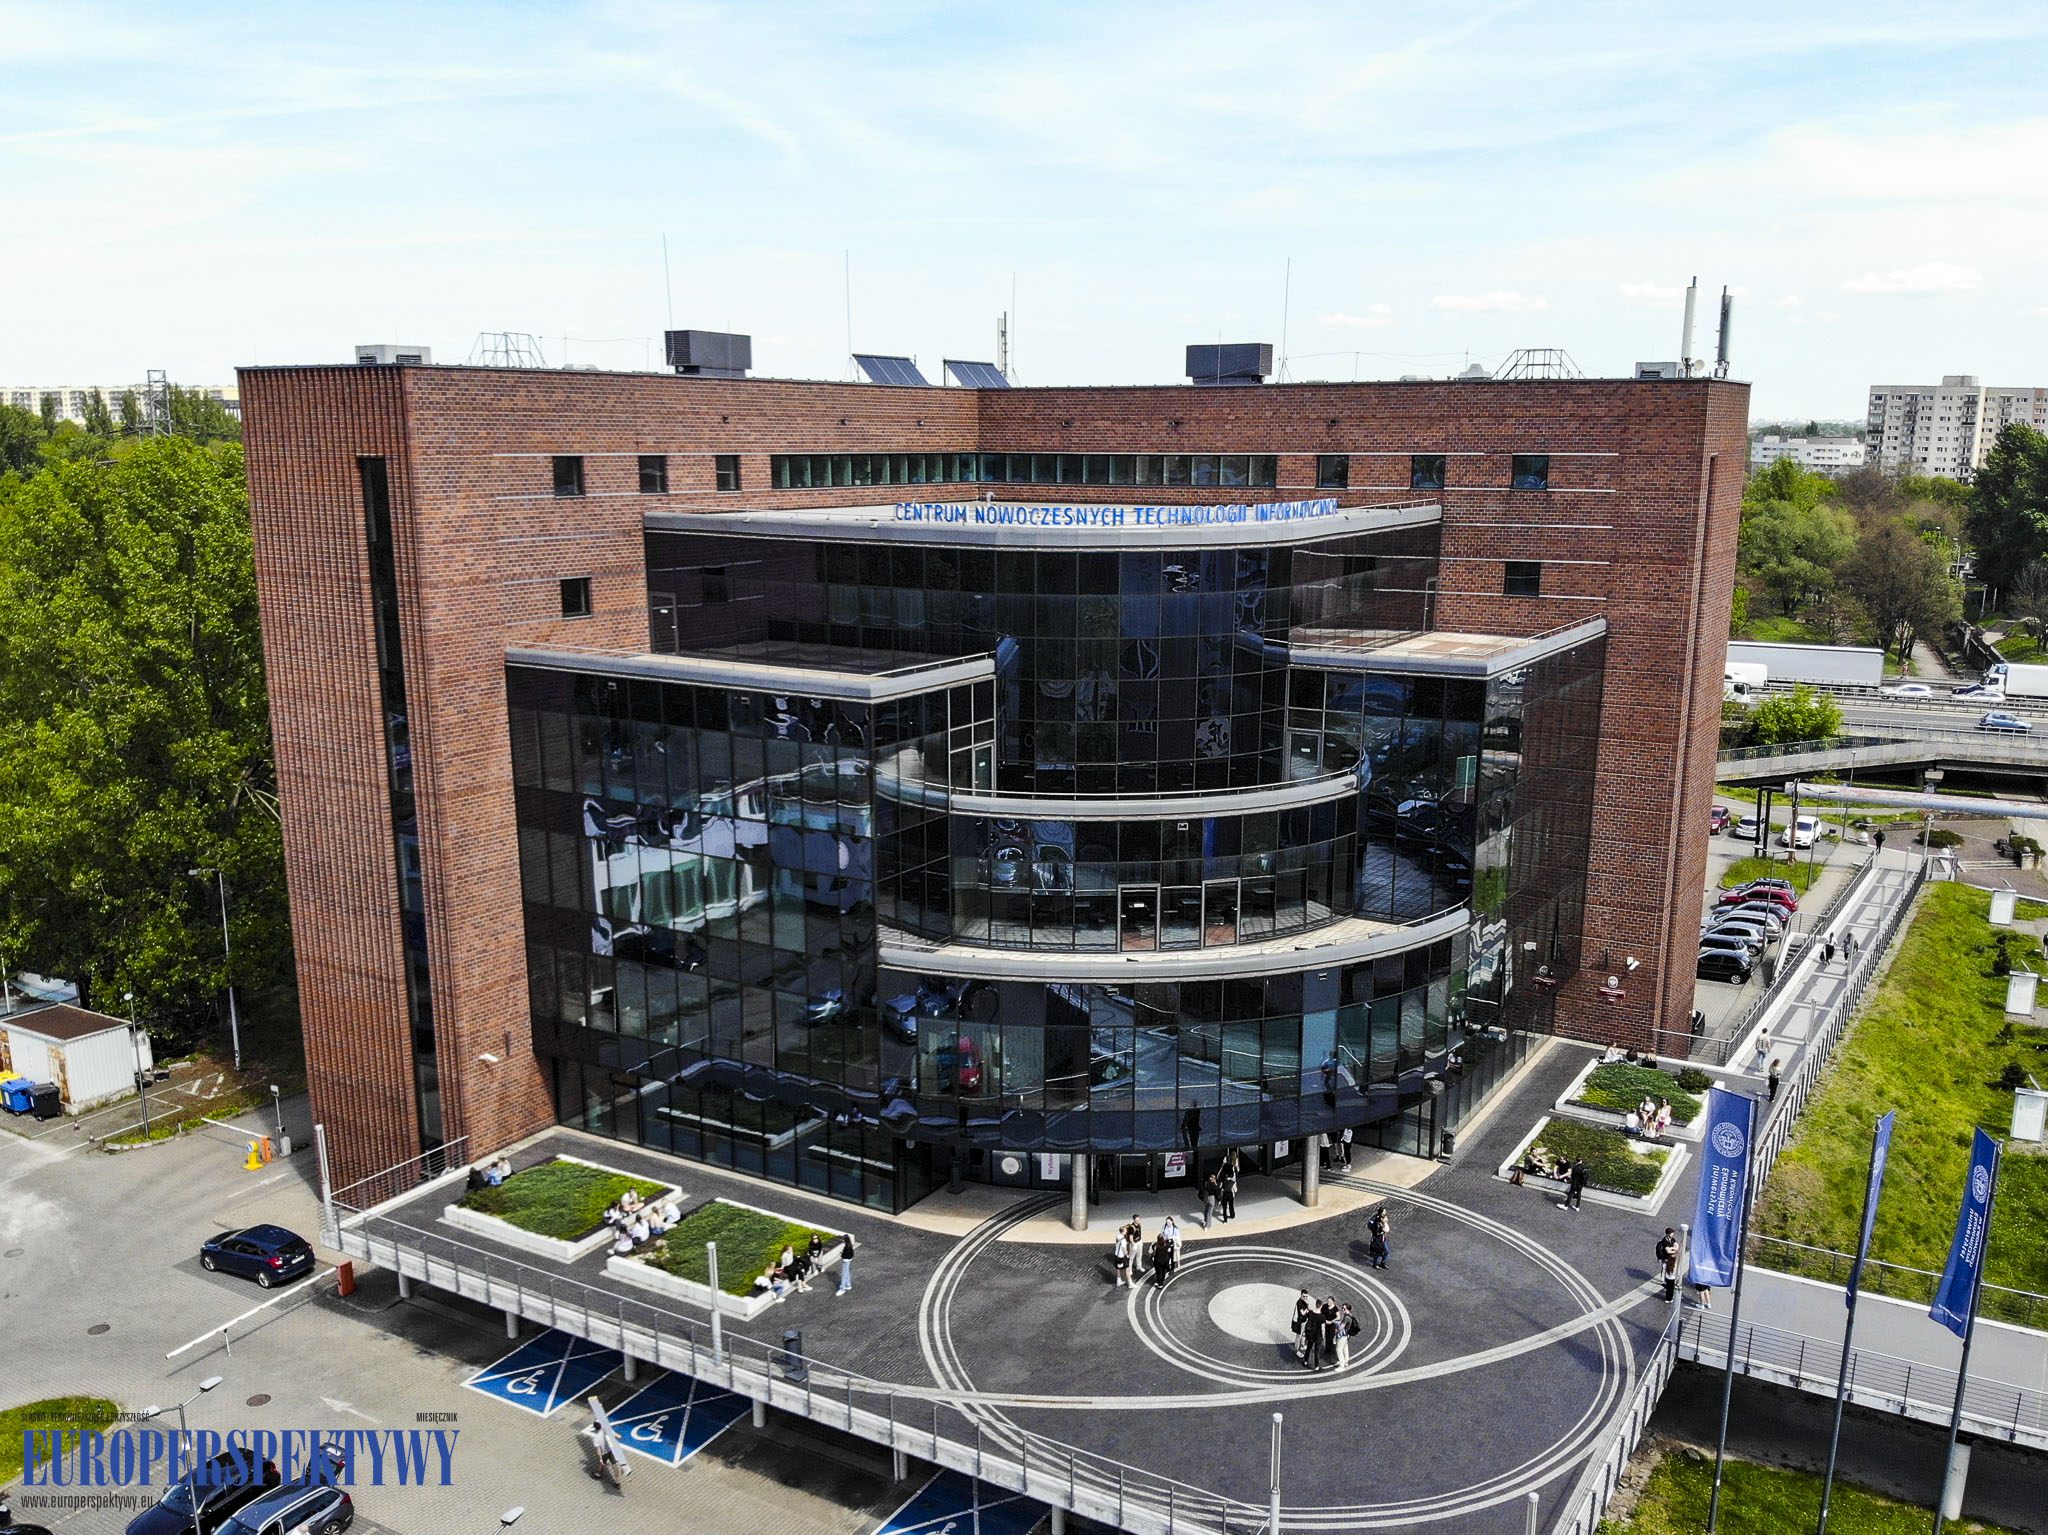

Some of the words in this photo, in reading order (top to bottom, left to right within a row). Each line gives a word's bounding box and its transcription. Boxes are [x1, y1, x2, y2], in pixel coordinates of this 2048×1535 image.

[895, 503, 967, 523] CENTRUM
[975, 504, 1125, 526] NOWOCZESNYCH
[1134, 504, 1248, 525] TECHNOLOGII
